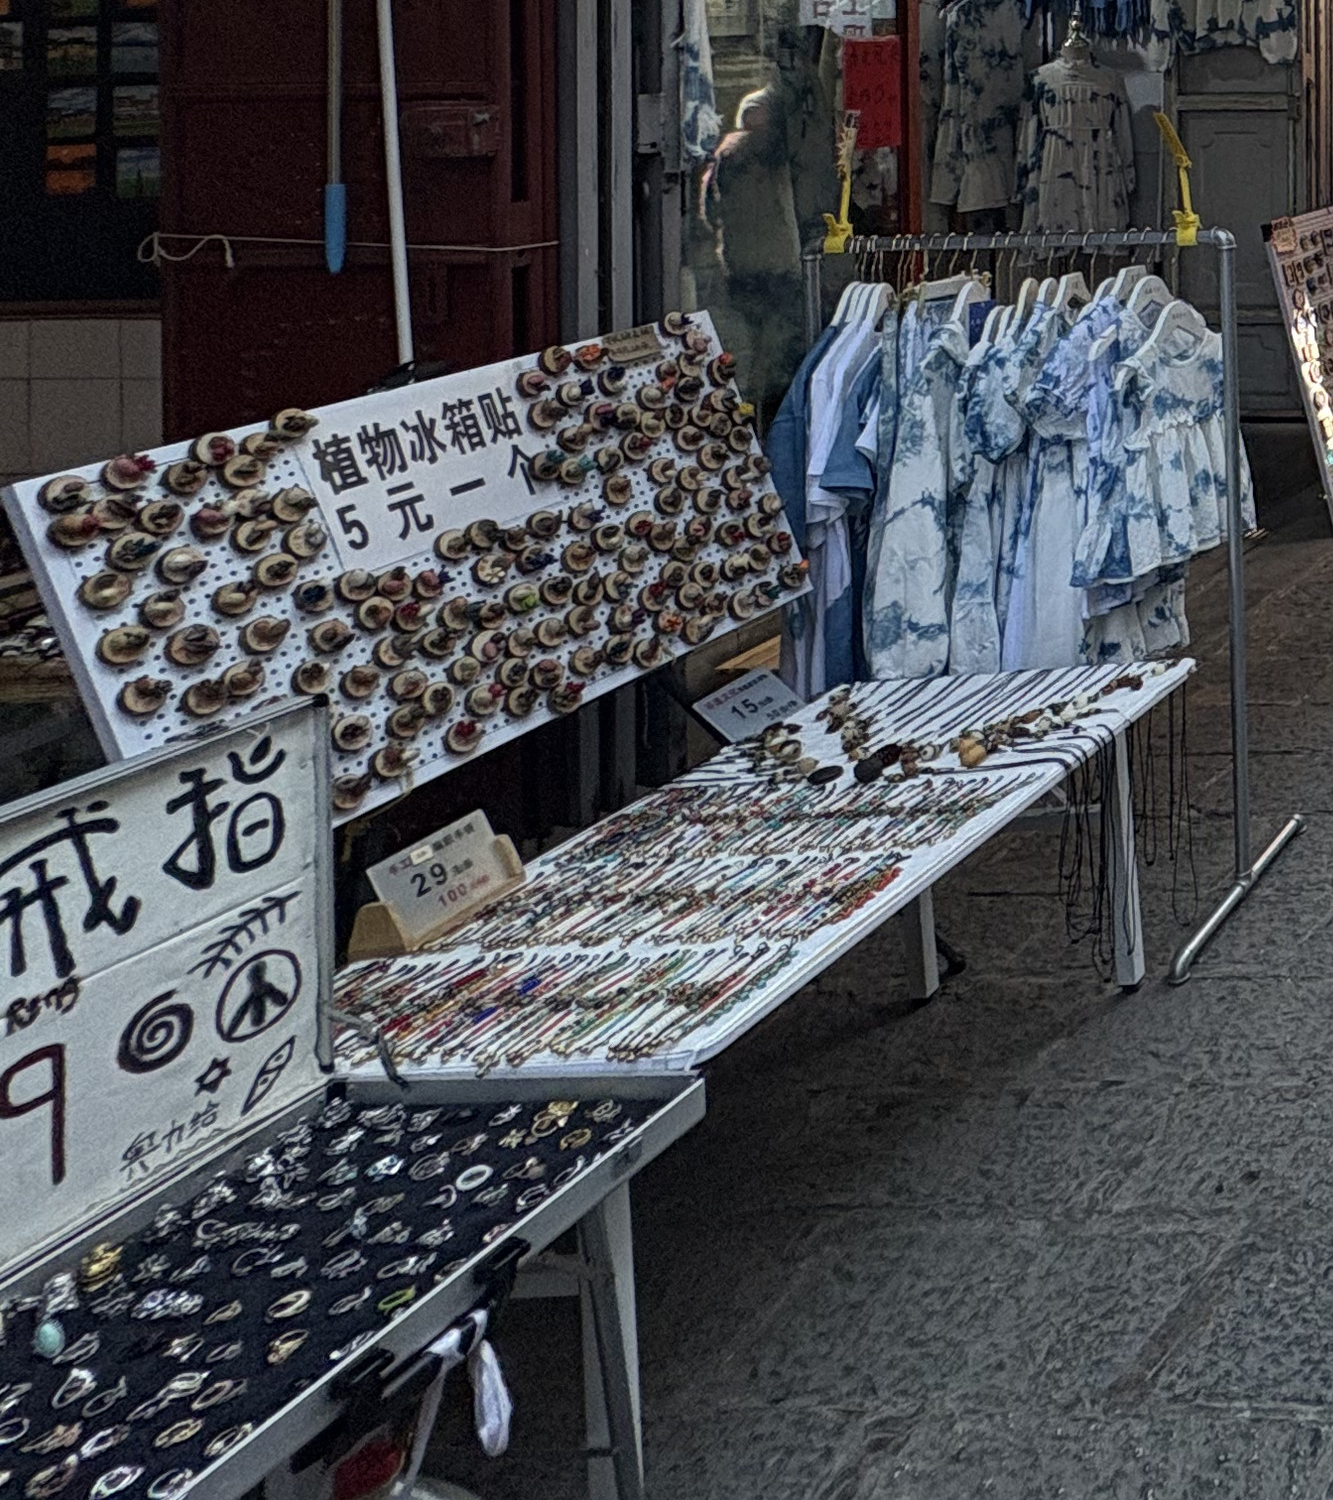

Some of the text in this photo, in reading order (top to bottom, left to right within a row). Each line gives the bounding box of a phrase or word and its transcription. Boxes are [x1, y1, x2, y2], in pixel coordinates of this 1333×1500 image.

[311, 387, 525, 496] 植物冰箱贴
[337, 443, 538, 551] 5元一个
[730, 698, 760, 719] 15
[0, 730, 288, 978] 戒指
[410, 862, 449, 898] 29
